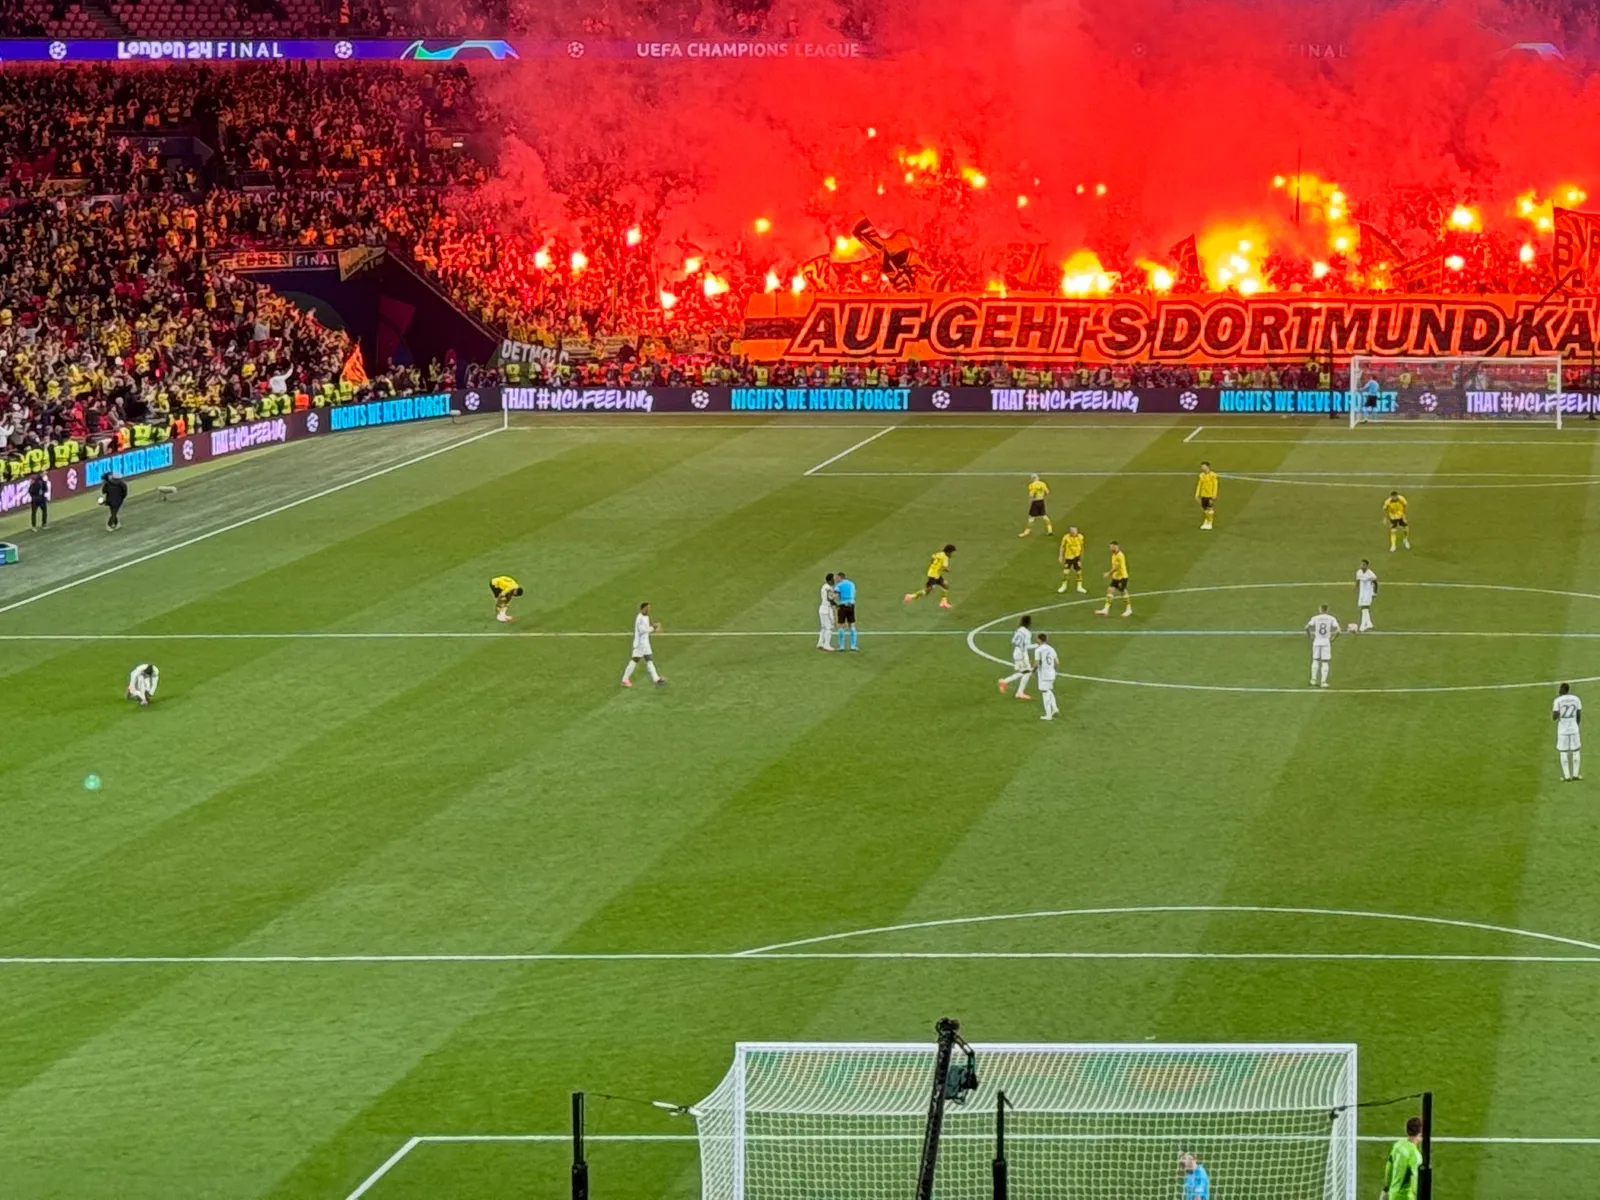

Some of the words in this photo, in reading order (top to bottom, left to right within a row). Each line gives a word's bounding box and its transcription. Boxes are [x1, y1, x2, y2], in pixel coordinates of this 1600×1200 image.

[188, 41, 213, 59] 24
[217, 42, 283, 58] FINAL
[636, 42, 683, 57] UEFA
[687, 42, 788, 58] CHAMPIONS
[795, 42, 860, 58] LEAGUE
[296, 253, 337, 267] FINAL
[797, 303, 930, 354] AUF
[1158, 306, 1506, 357] DORTMUND
[536, 388, 654, 412] #UCLFEELING
[730, 388, 784, 410] NIGHTS
[786, 388, 807, 410] WE
[809, 389, 855, 410] NEVER
[857, 389, 912, 410] FORGET
[991, 389, 1024, 410] THAT
[1024, 389, 1139, 413] #UCLFEELING
[1219, 390, 1273, 411] NIGHTS
[1274, 390, 1296, 411] WE
[1297, 390, 1343, 412] NEVER
[1465, 391, 1498, 413] THAT
[331, 405, 367, 430] NIGHTS
[367, 402, 382, 425] WE
[383, 399, 414, 422] NEVER
[414, 394, 452, 418] FORGET
[1318, 624, 1328, 636] 8
[1045, 654, 1052, 666] 6
[1560, 704, 1576, 719] 22
